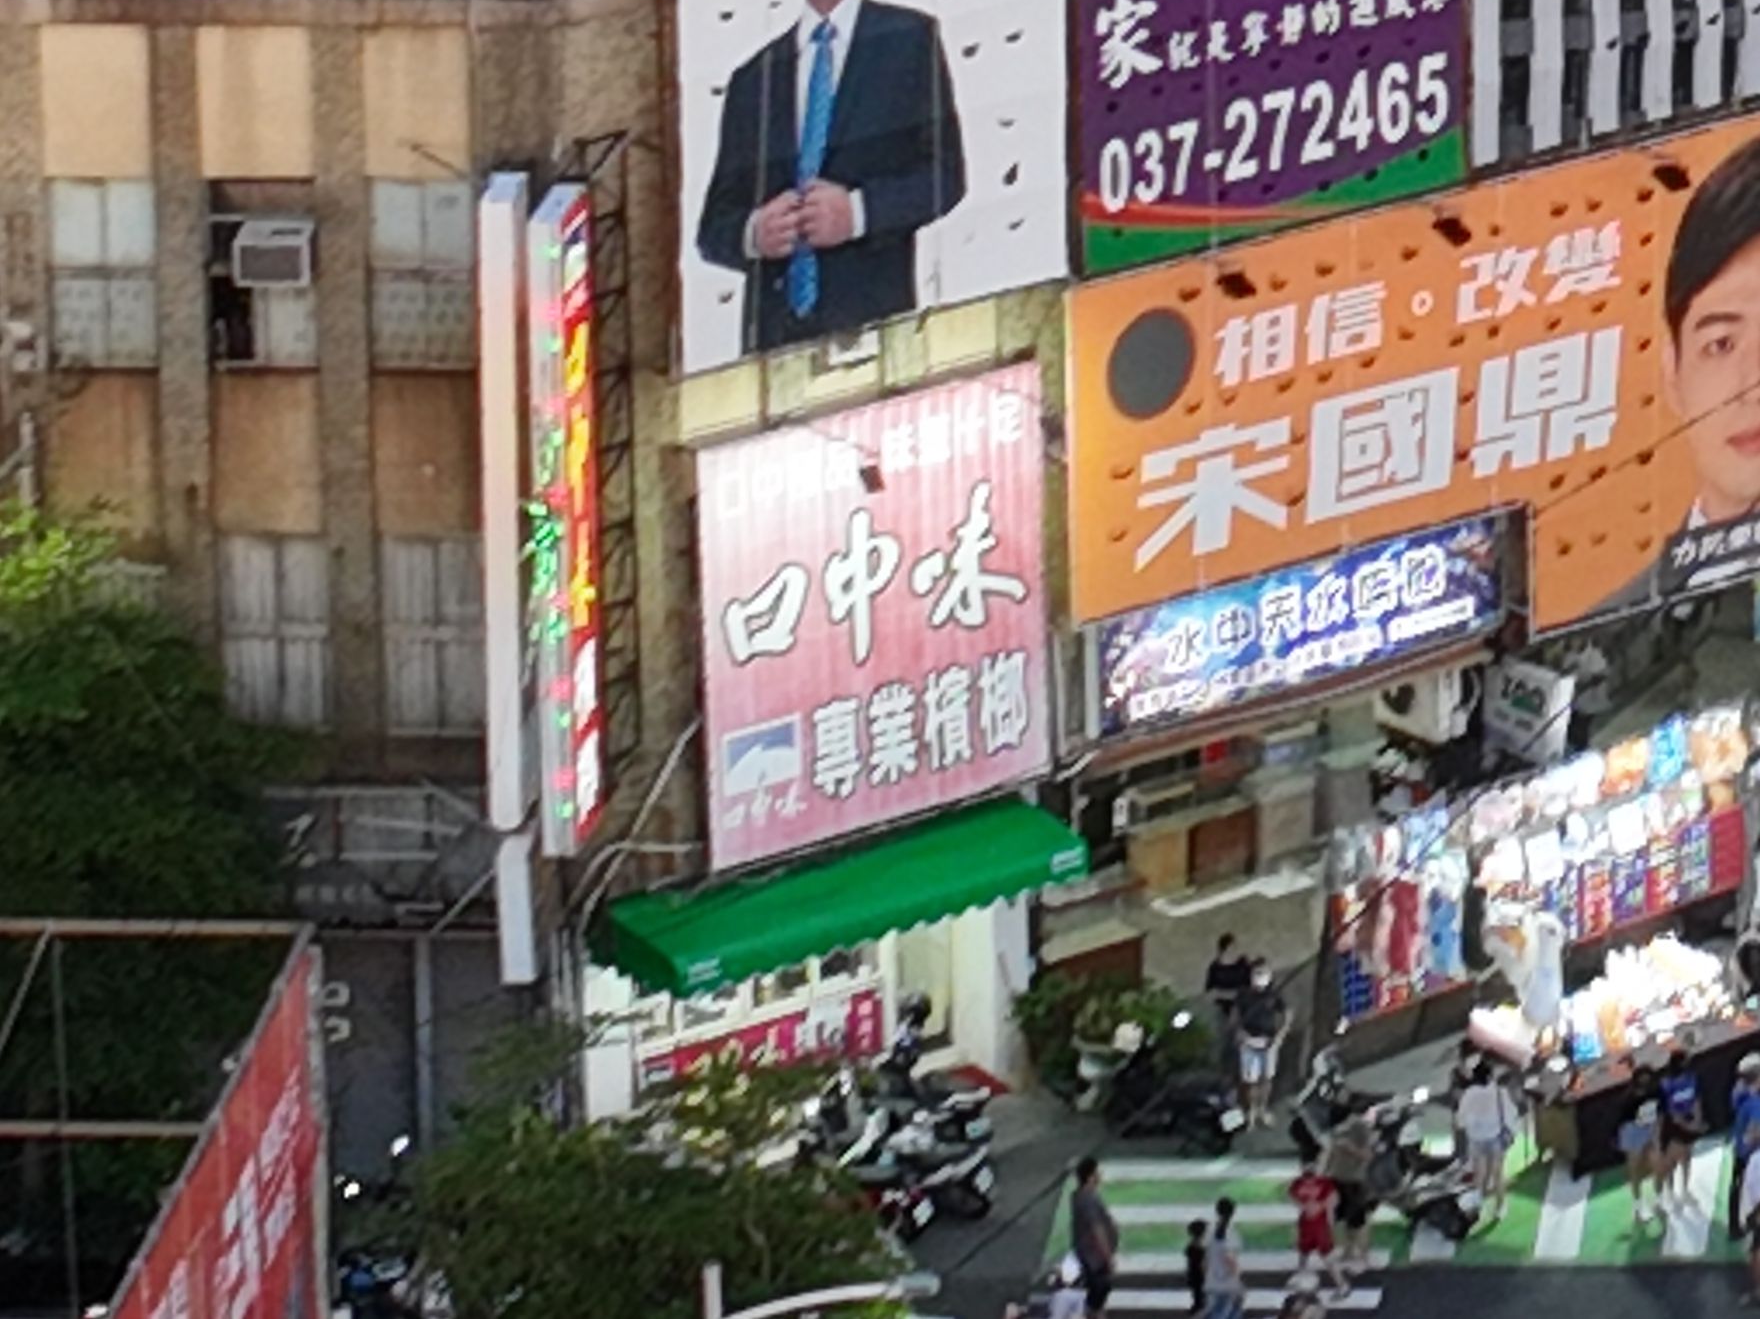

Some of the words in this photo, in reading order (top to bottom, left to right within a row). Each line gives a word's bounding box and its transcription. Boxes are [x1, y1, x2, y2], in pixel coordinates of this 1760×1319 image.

[1101, 53, 1449, 212] 037-272465
[1134, 327, 1625, 571] 宋國鼎
[723, 480, 1027, 667] 口中味
[811, 648, 1029, 803] 專業檳榔
